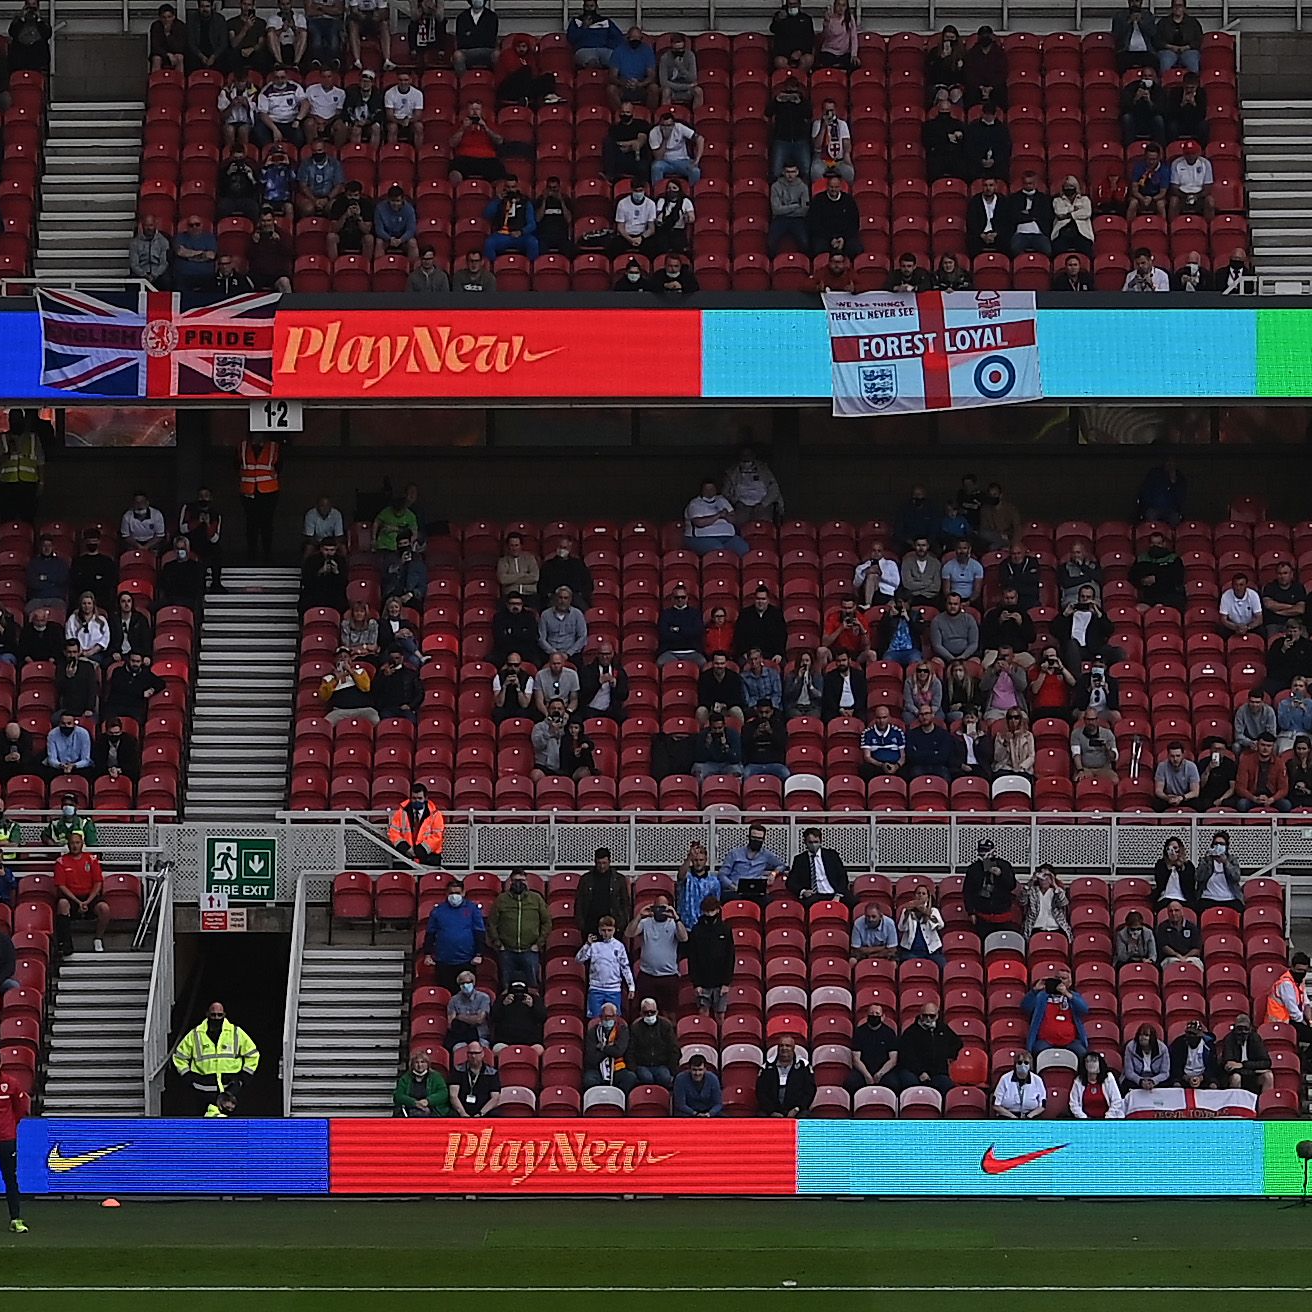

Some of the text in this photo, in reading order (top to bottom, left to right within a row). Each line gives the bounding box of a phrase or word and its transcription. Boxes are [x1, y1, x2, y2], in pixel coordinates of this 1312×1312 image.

[867, 308, 896, 319] NEVER
[898, 307, 915, 317] SEE
[185, 330, 257, 347] PRIDE
[858, 327, 1009, 359] FOREST LOYAL
[277, 320, 524, 389] PlayNew
[211, 884, 270, 896] FIRE EXIT
[440, 1126, 649, 1186] PlayNew
